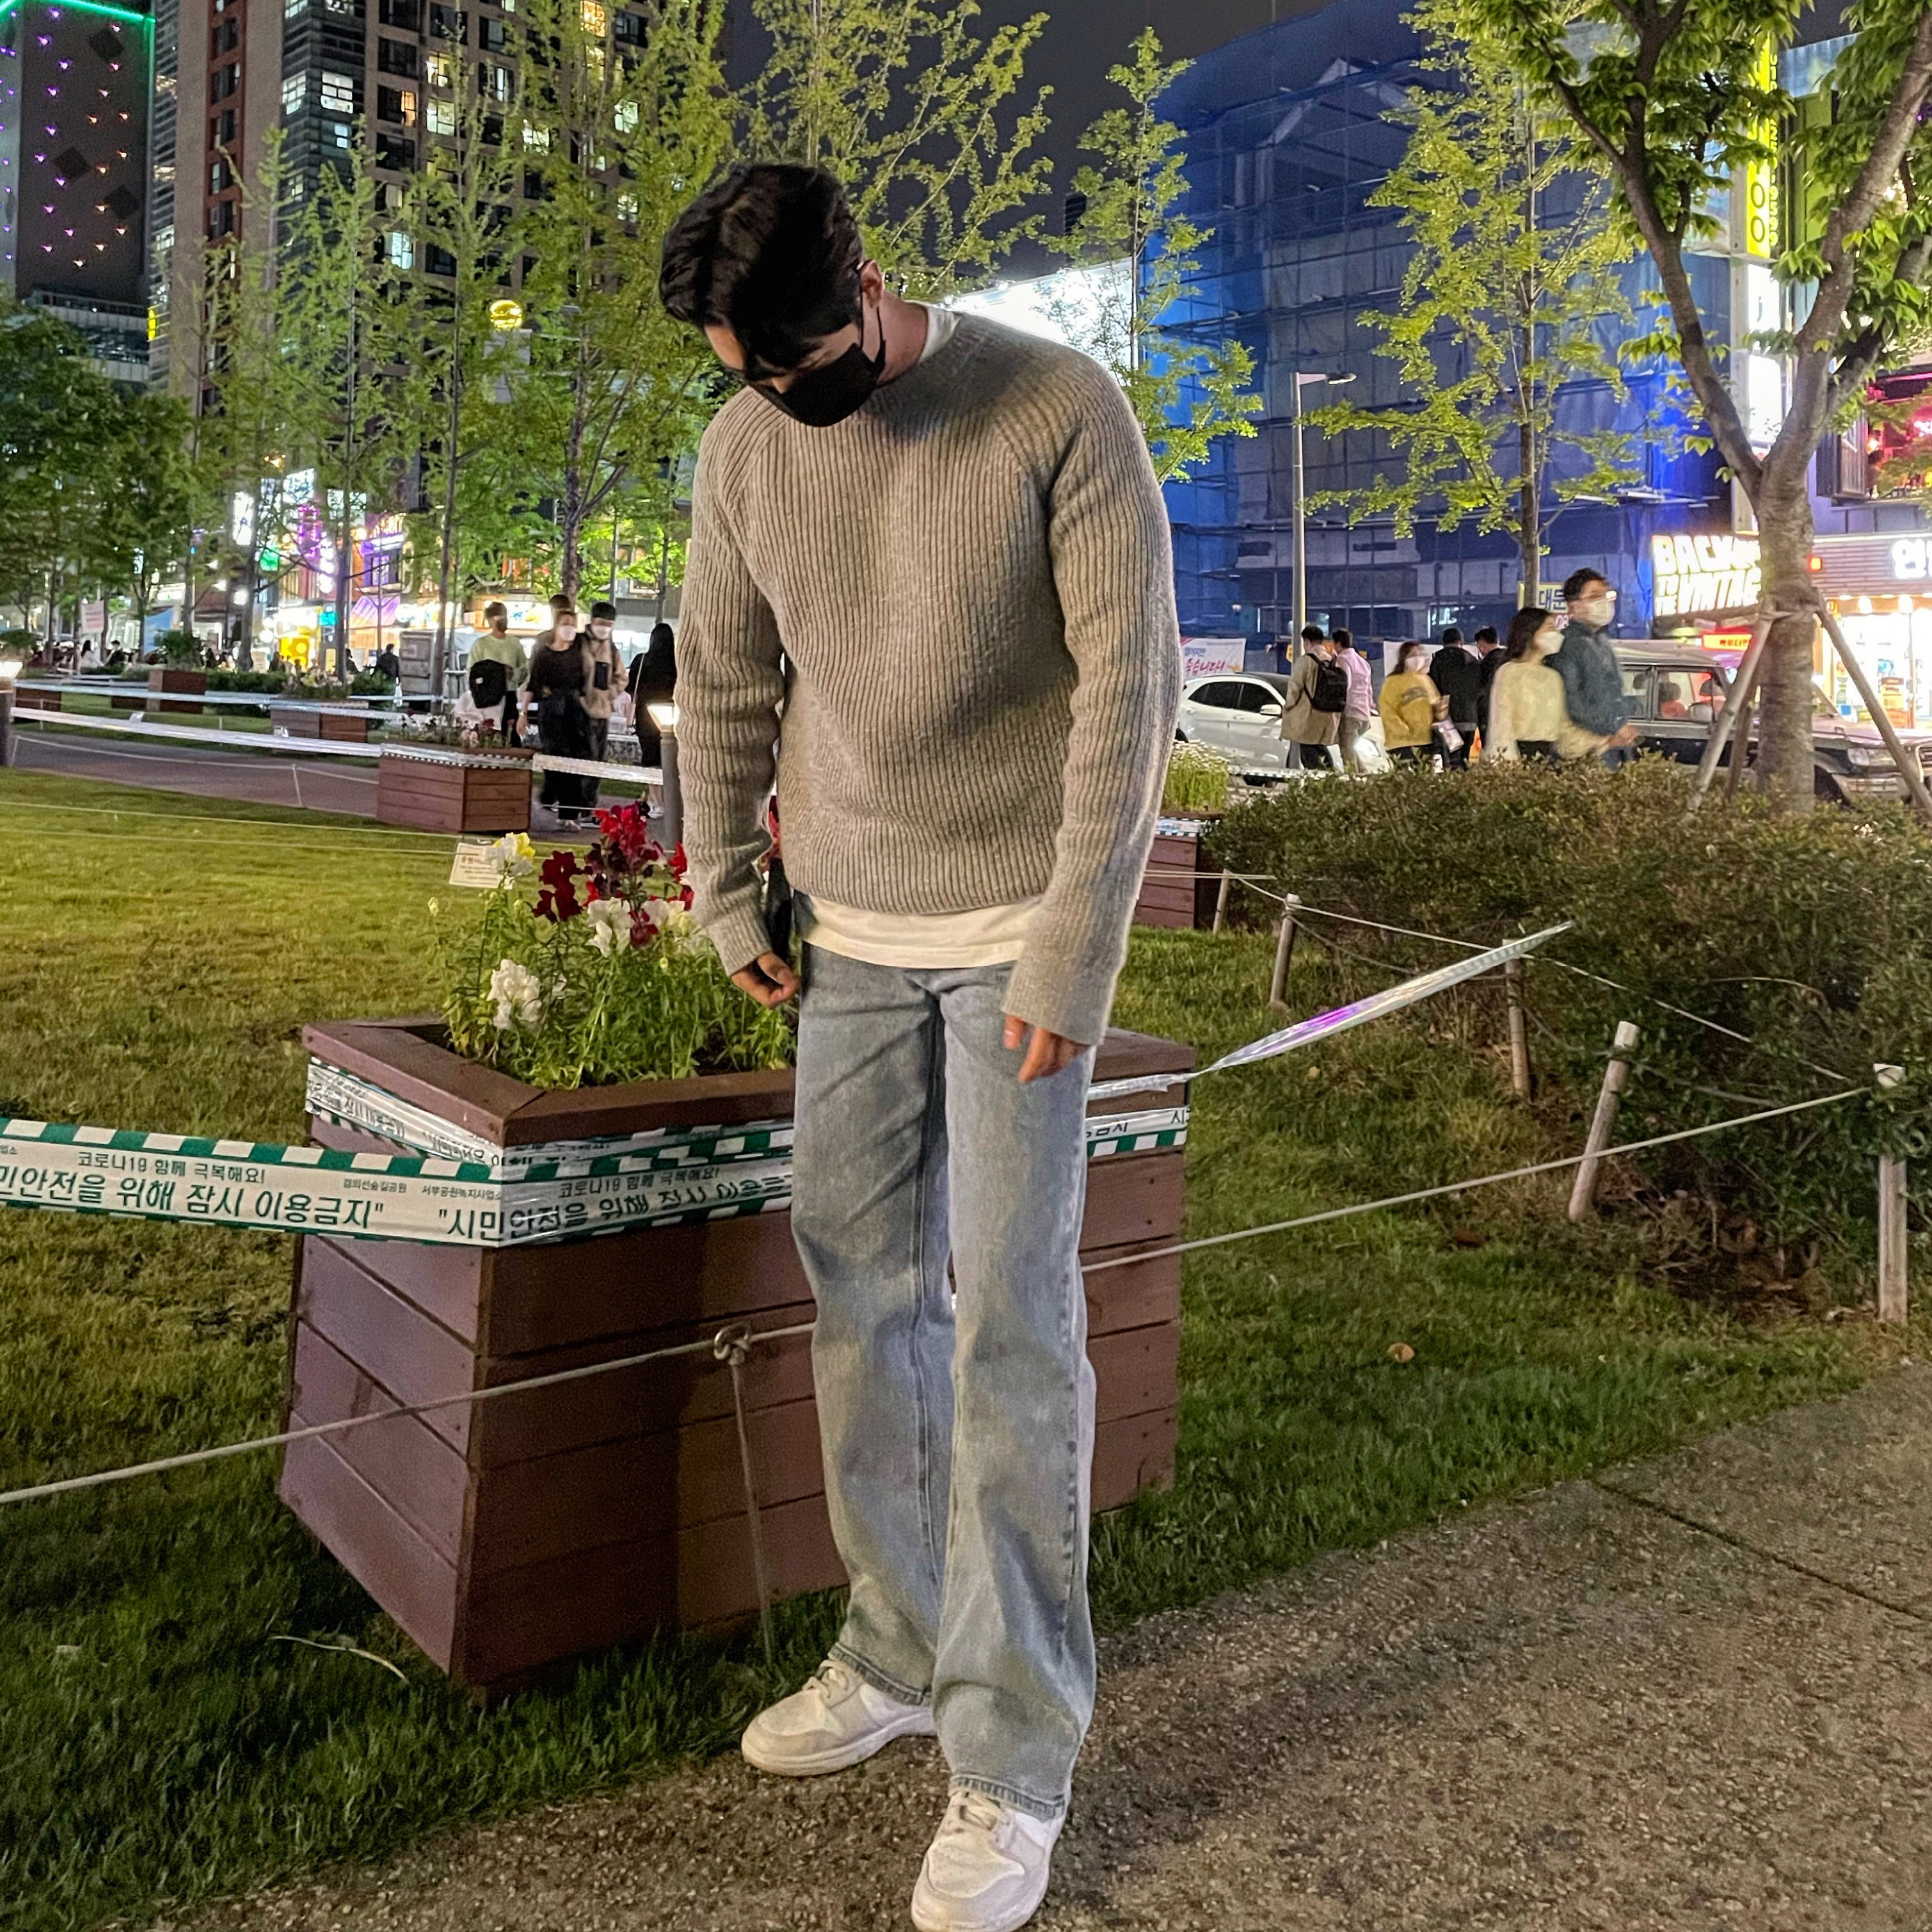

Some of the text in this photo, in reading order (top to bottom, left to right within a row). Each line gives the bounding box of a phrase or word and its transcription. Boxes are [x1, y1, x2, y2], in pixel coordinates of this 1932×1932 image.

[1677, 568, 1761, 614] VINTAG
[78, 1151, 265, 1184] 코로나19 함께 극복해요!
[116, 1177, 176, 1211] 위해
[186, 1184, 244, 1217] 잠시
[256, 1190, 383, 1229] 이용금지"
[559, 1178, 619, 1199] 코로나19
